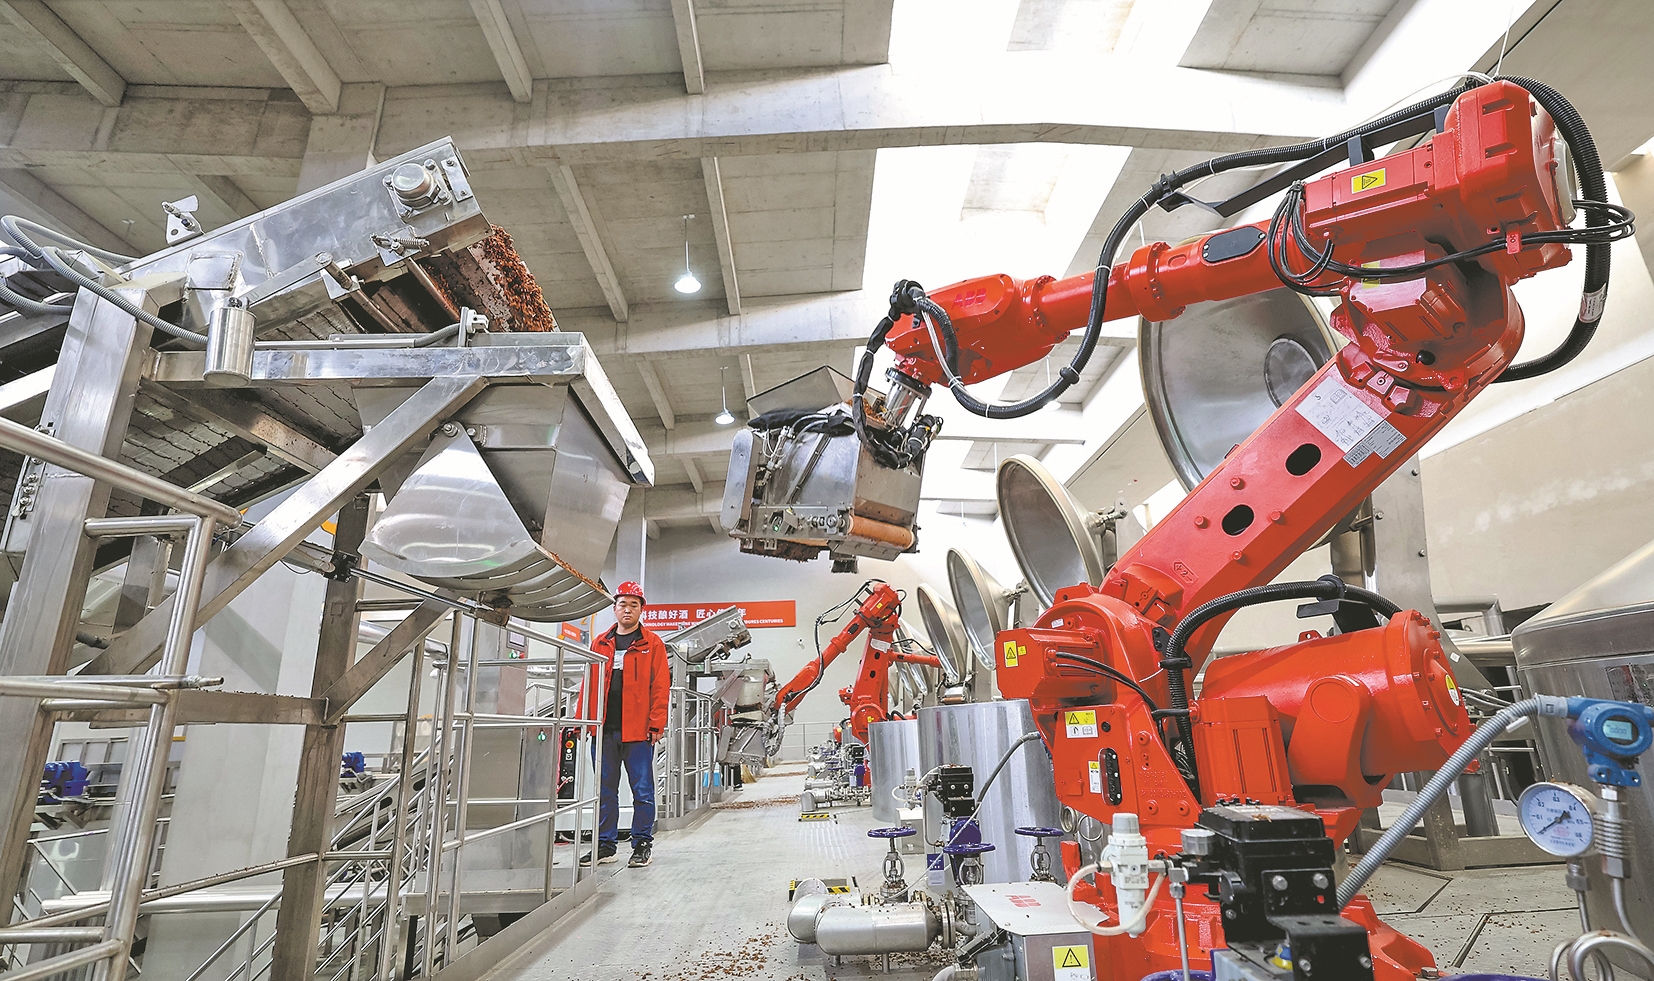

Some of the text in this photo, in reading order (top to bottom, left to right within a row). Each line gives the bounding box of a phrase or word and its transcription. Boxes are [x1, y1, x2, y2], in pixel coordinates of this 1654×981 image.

[951, 288, 986, 309] ABB
[696, 608, 746, 619] 匠心年
